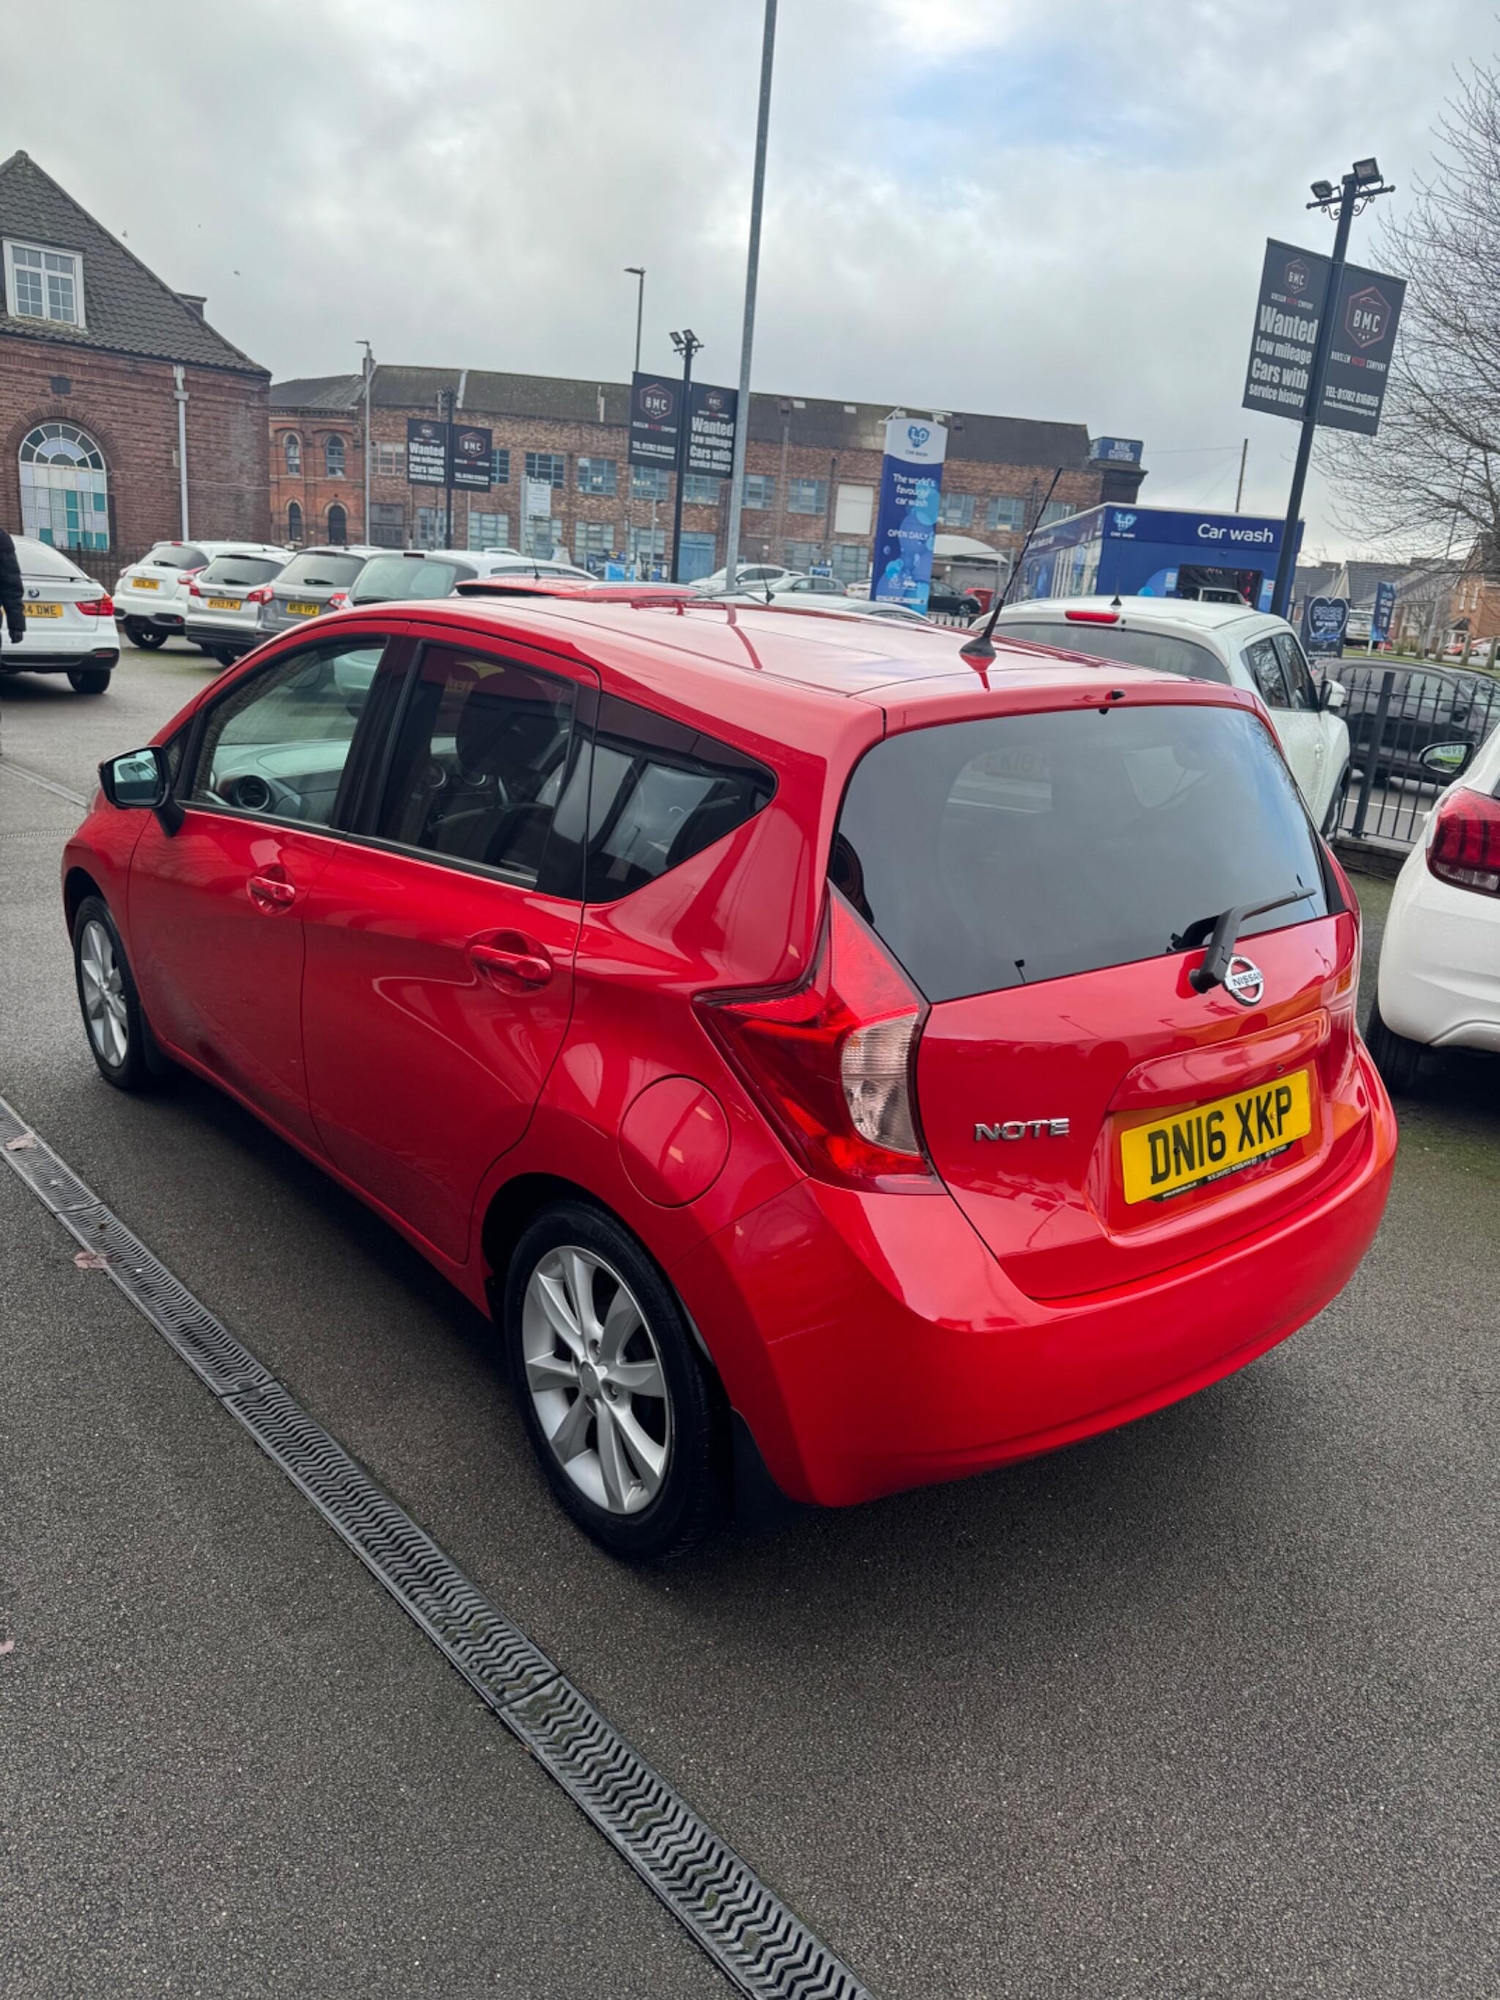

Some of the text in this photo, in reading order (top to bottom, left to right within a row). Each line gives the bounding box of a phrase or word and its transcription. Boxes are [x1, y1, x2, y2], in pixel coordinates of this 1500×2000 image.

[1259, 304, 1319, 344] Wanted
[1353, 309, 1381, 333] BMC
[1255, 335, 1313, 366] Low mileage
[1251, 357, 1309, 390] Cars with
[645, 396, 668, 411] BMC
[1248, 383, 1306, 408] service history
[691, 416, 735, 437] Wanted
[408, 441, 445, 457] Wanted
[690, 432, 733, 449] Low mileage
[689, 444, 711, 460] Cars
[712, 448, 733, 463] with
[689, 458, 731, 473] service history
[892, 472, 936, 488] The world's
[895, 497, 908, 506] car
[887, 528, 929, 541] OPEN DAILY
[1197, 523, 1274, 544] Car wash
[1231, 971, 1263, 987] NISSAN
[974, 1117, 1070, 1142] NOTE
[1147, 1085, 1293, 1185] DN16 XKP
